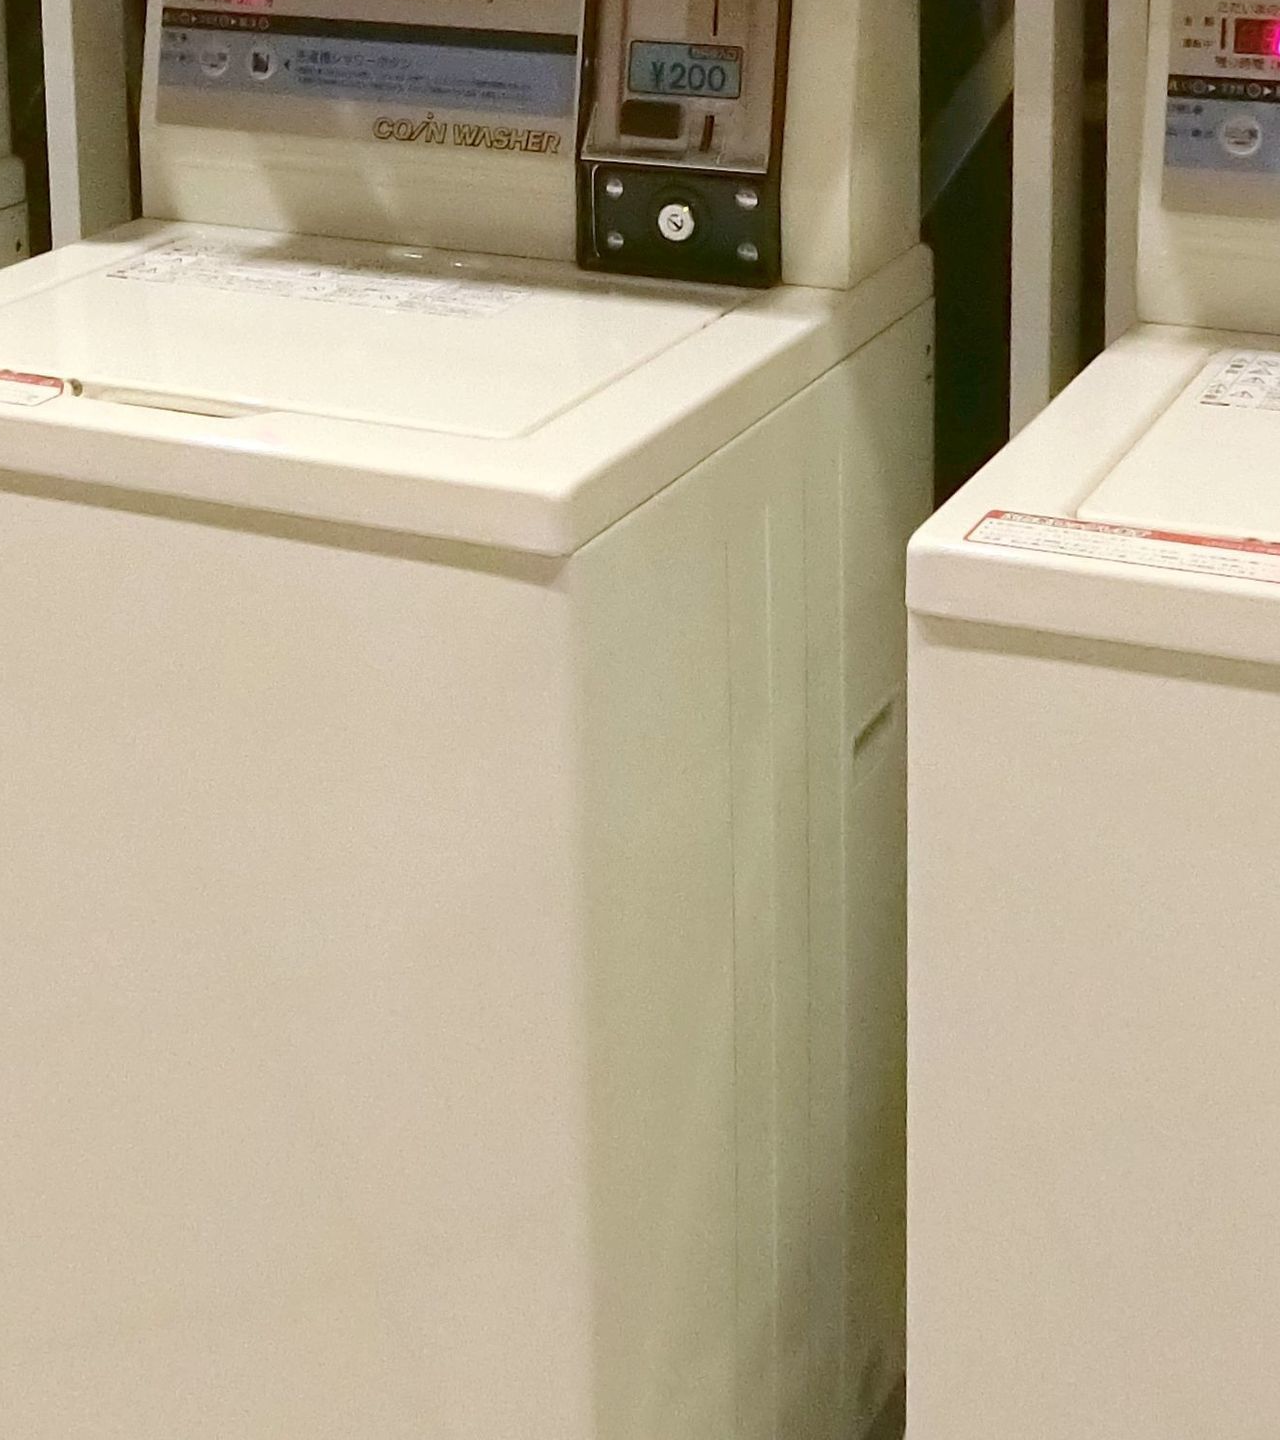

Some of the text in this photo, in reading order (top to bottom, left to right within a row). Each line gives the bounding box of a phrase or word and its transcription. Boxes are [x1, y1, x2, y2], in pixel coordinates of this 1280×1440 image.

[651, 62, 726, 92] ¥200
[372, 112, 562, 153] COIN WASHER
